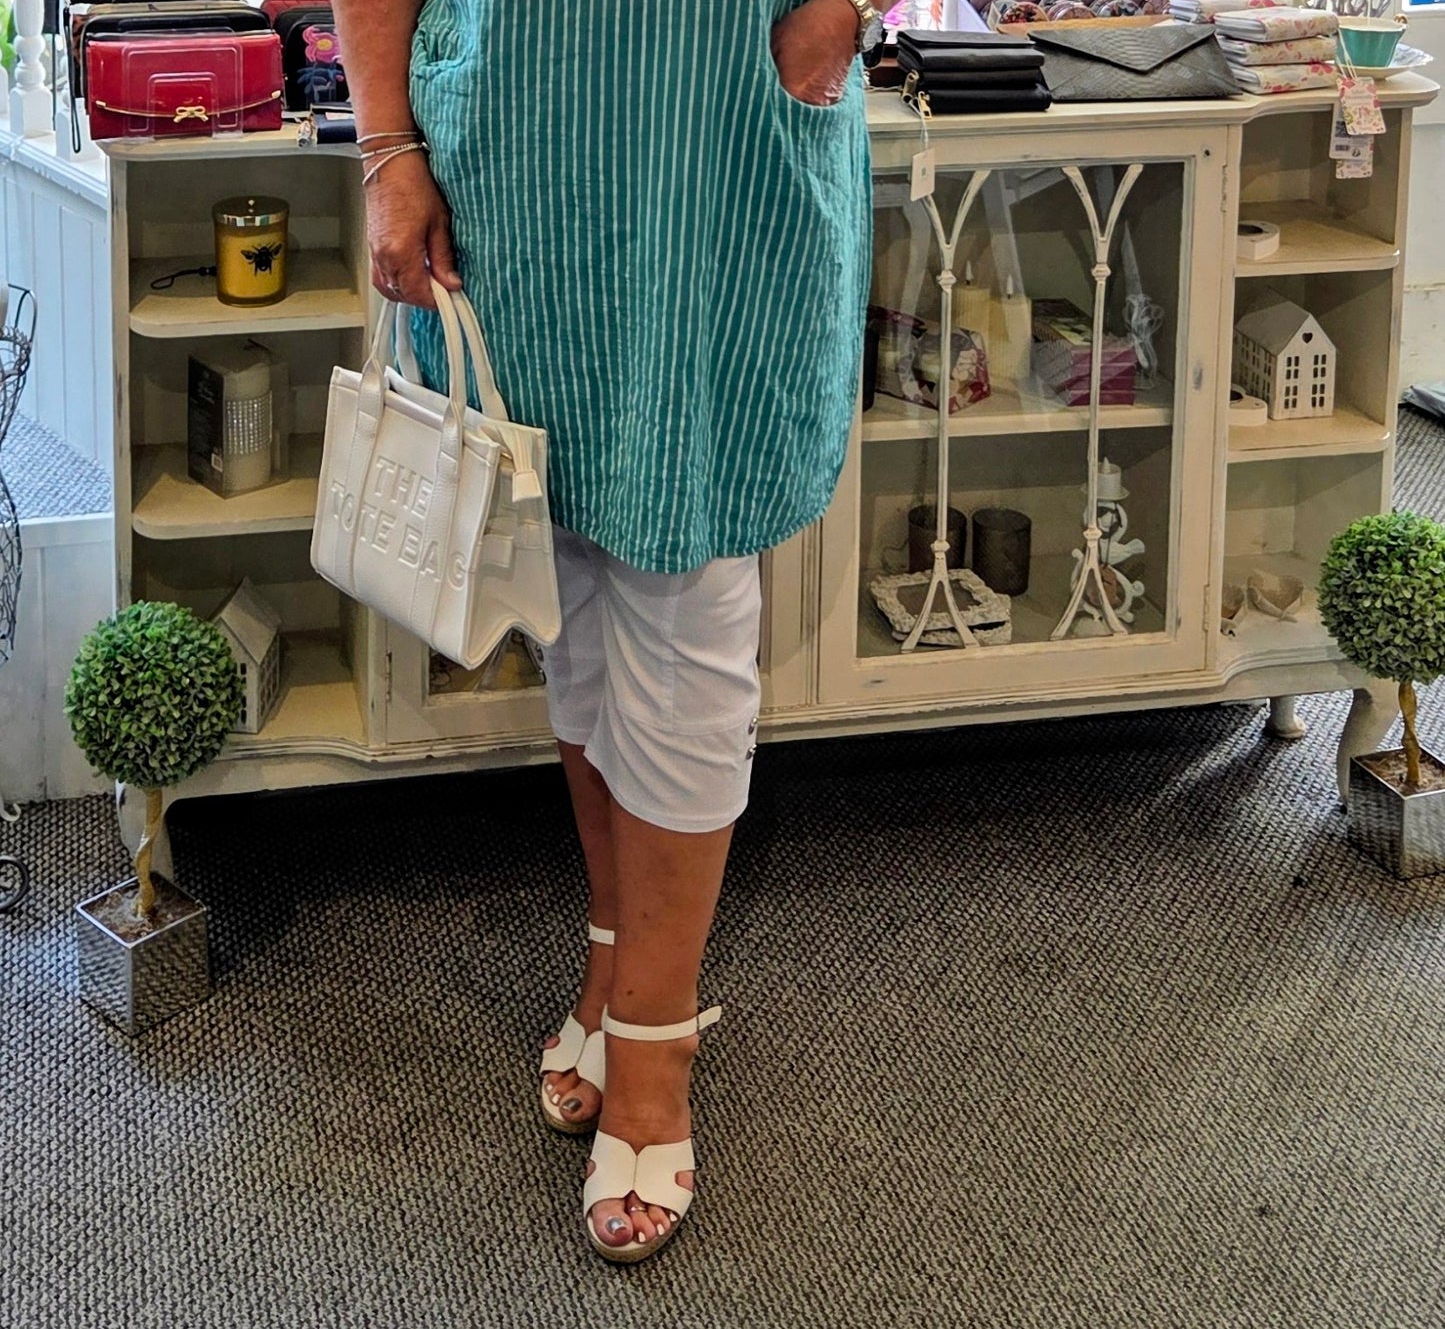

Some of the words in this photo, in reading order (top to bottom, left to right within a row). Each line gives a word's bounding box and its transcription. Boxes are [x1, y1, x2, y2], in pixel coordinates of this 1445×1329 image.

[374, 454, 435, 520] THE
[330, 479, 398, 554] TOTE
[397, 523, 467, 591] BAG
